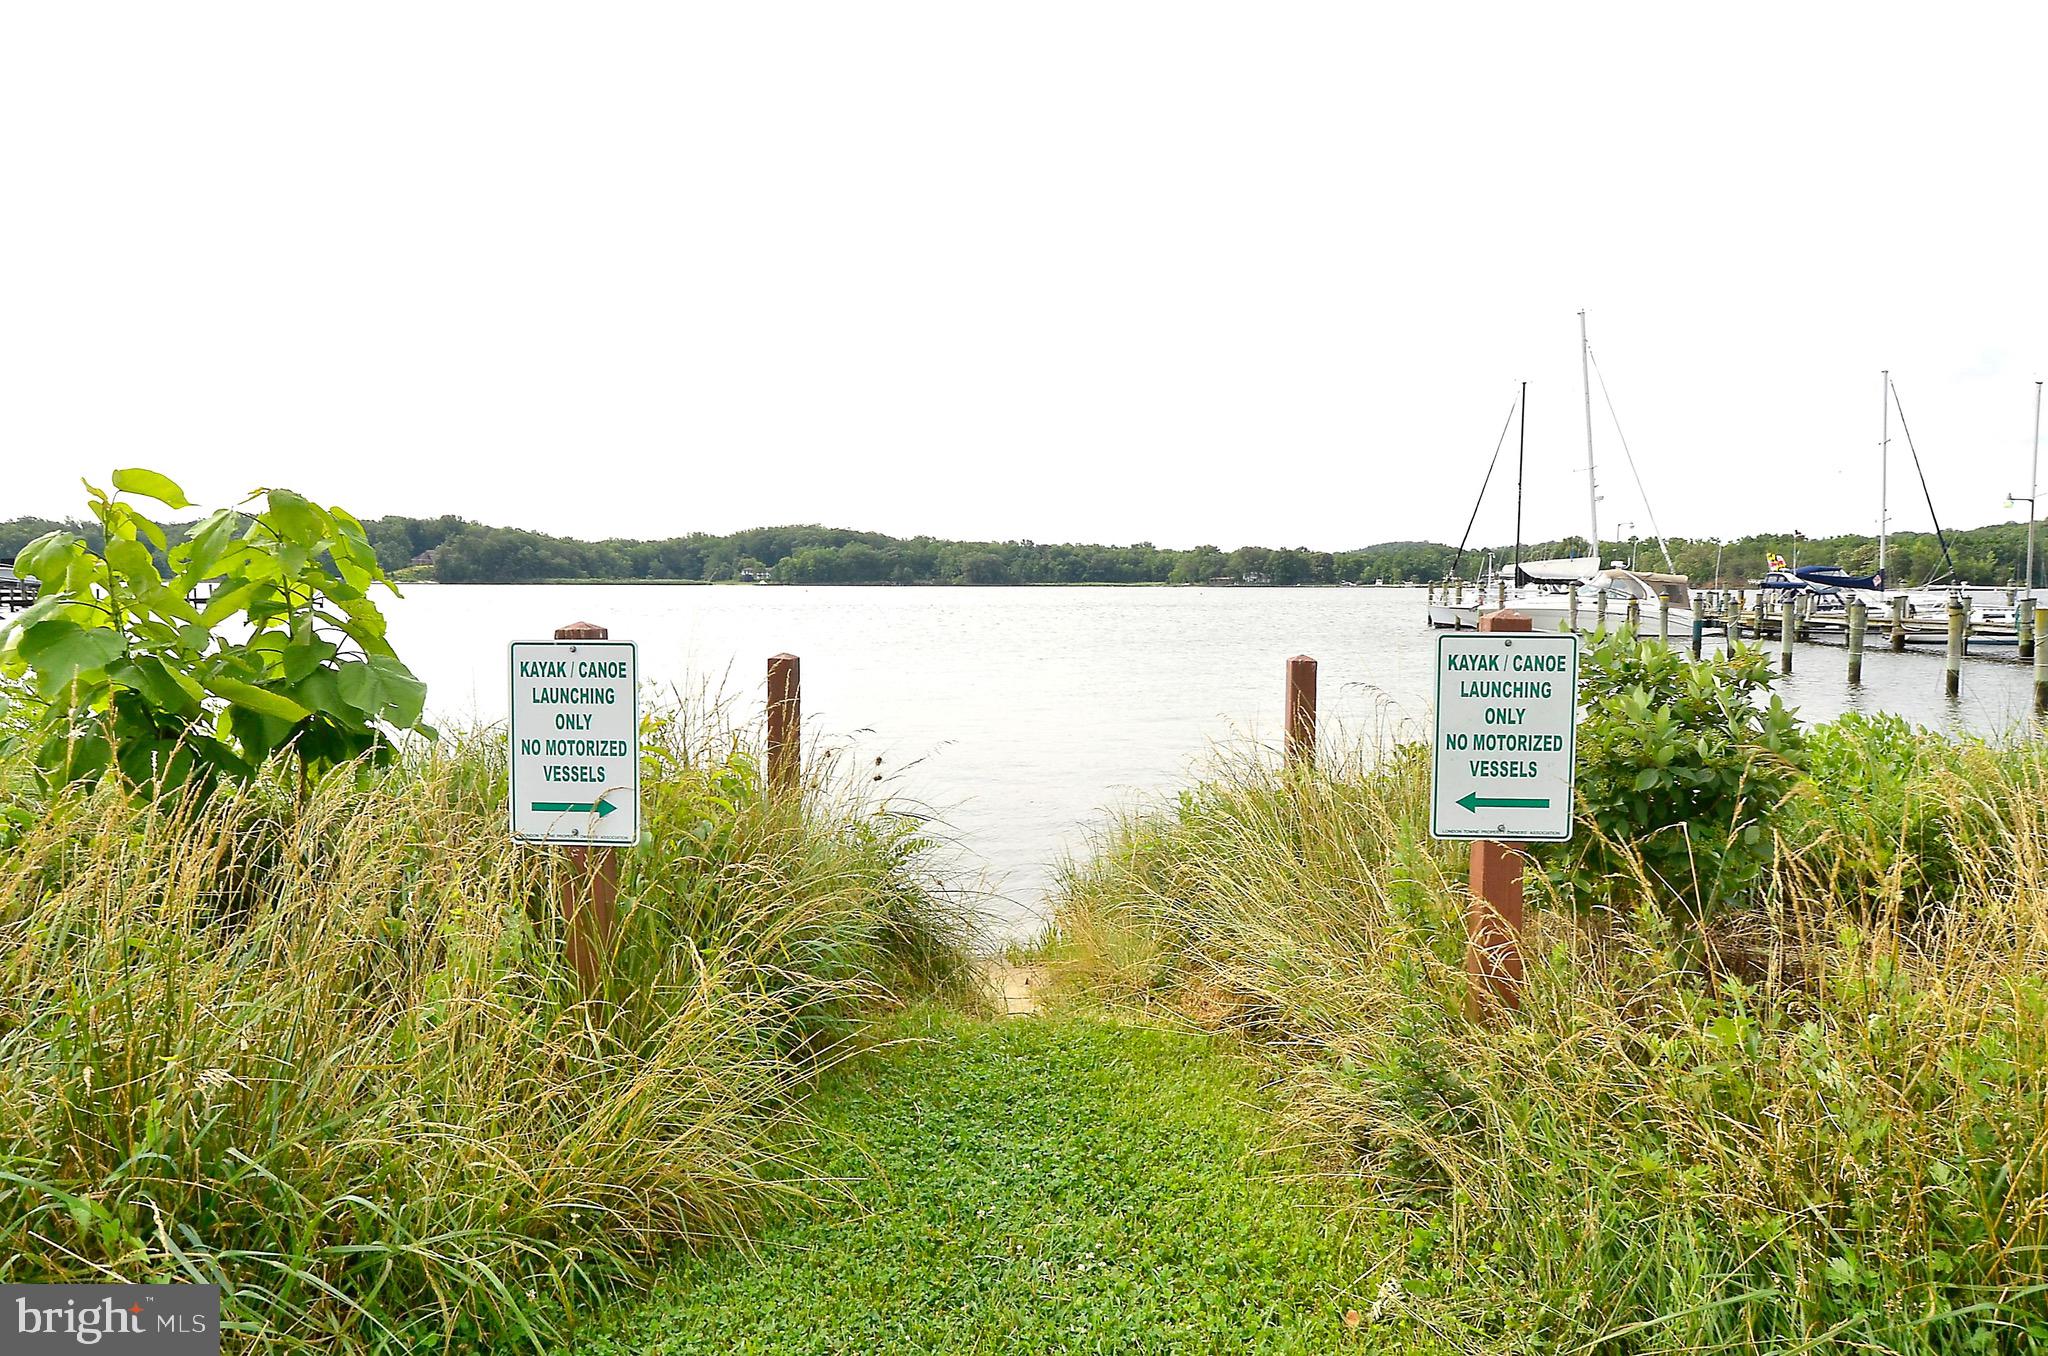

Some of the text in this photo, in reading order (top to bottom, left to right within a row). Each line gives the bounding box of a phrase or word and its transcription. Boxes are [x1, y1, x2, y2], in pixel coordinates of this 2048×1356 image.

[520, 661, 627, 678] KAYAK / CANOE
[1448, 654, 1566, 672] KAYAK / CANOE
[532, 687, 615, 704] LAUNCHING
[1460, 681, 1552, 698] LAUNCHING
[555, 713, 592, 730] ONLY
[1485, 708, 1526, 725] ONLY
[521, 739, 627, 757] NO MOTORIZED
[1446, 734, 1563, 752] NO MOTORIZED
[544, 765, 605, 783] VESSELS
[1470, 760, 1537, 778] VESSELS
